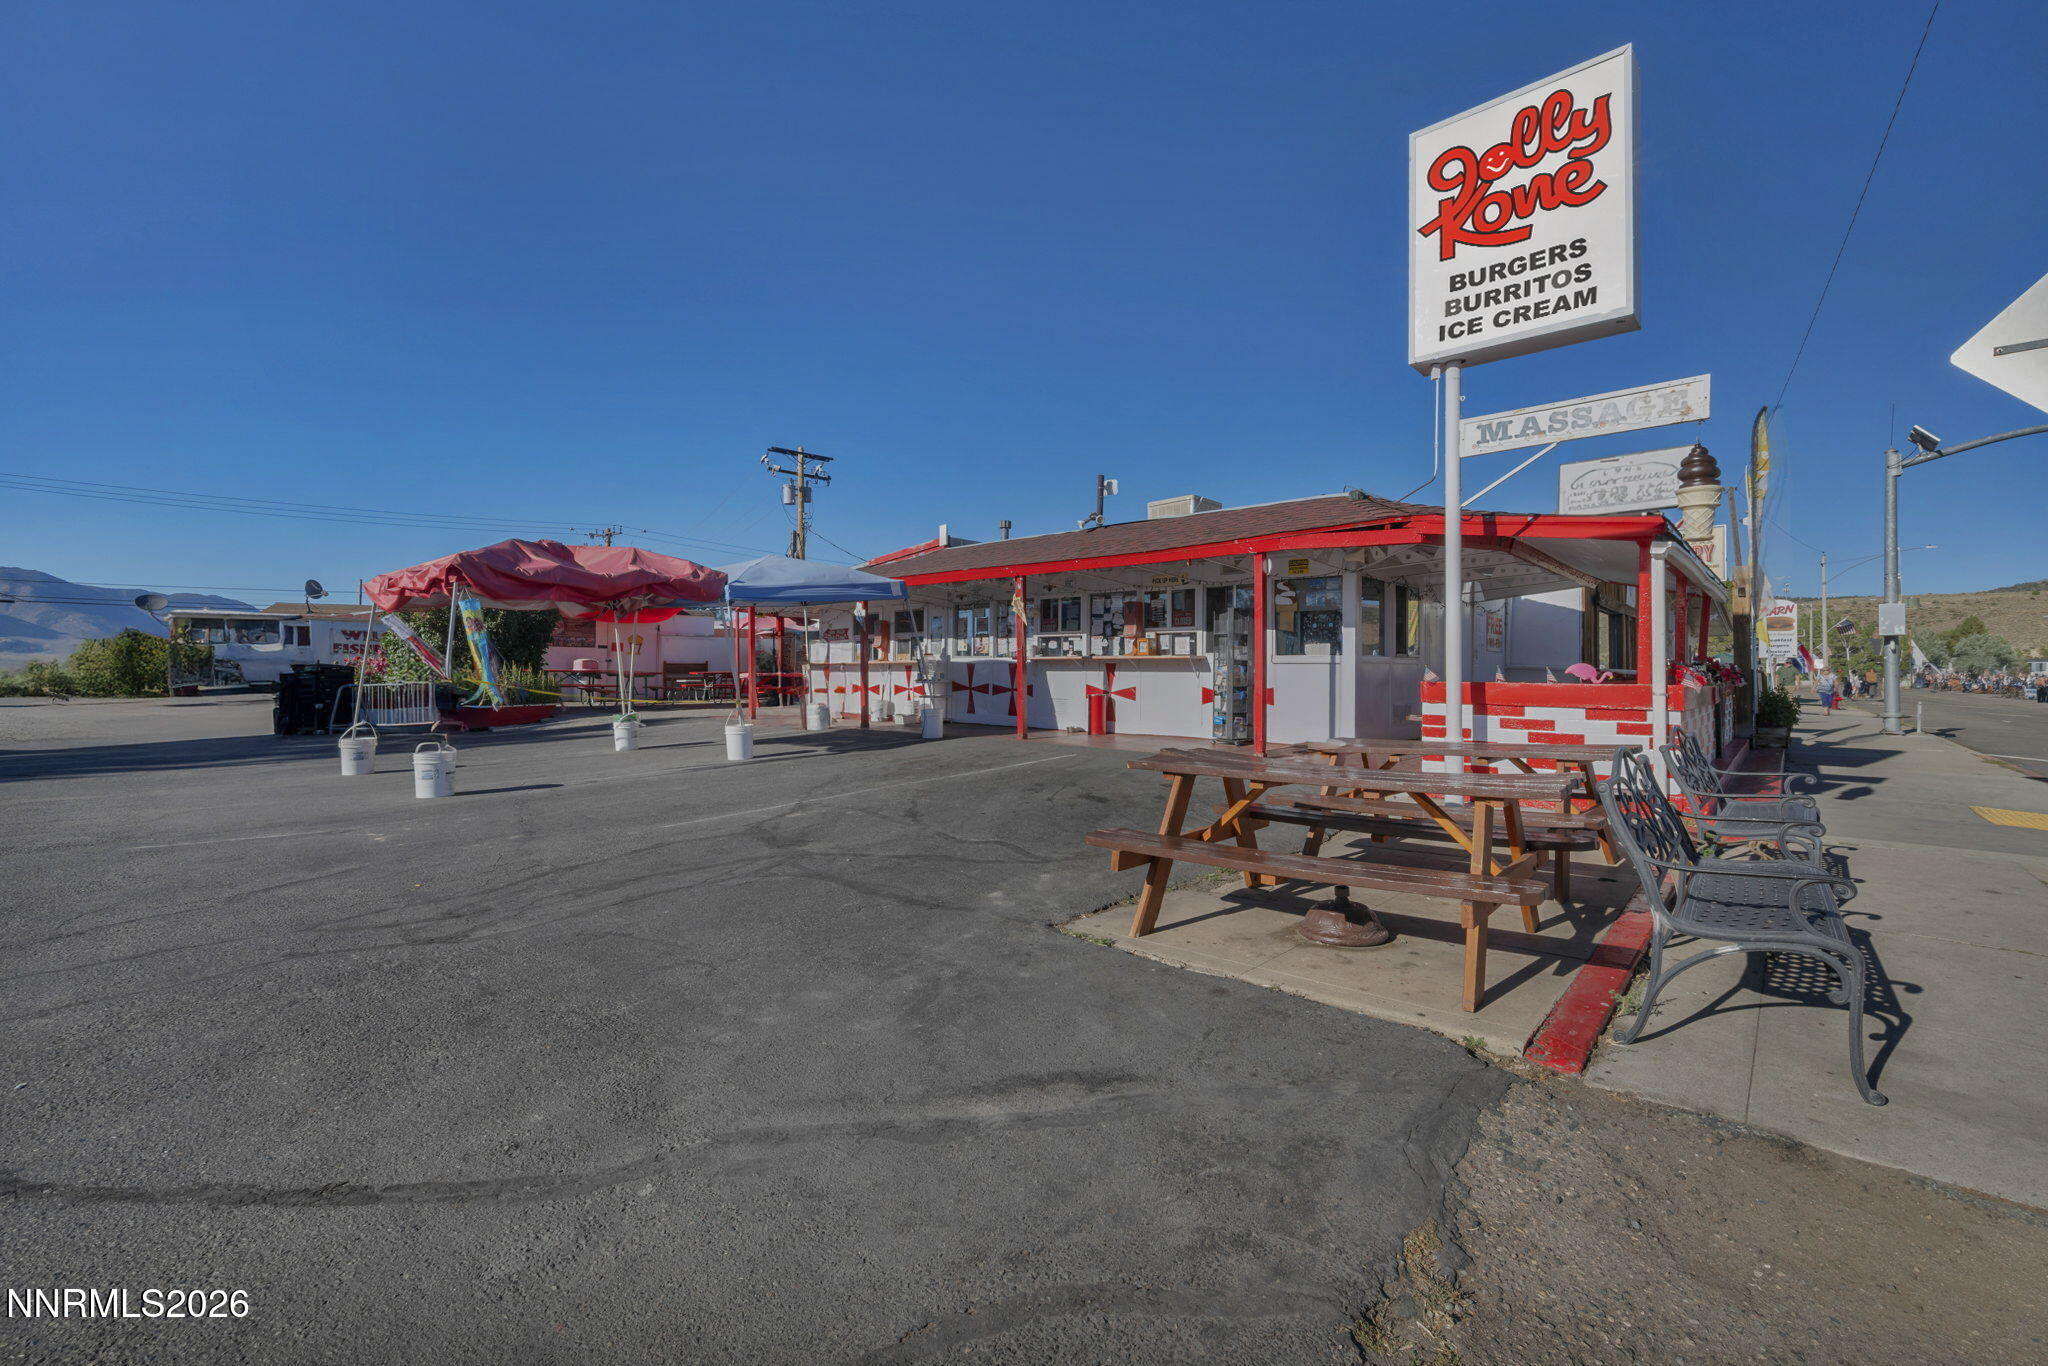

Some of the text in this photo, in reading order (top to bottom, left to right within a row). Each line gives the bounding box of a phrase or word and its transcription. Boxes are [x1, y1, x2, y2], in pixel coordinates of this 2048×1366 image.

[1422, 89, 1612, 222] Jolly
[1430, 159, 1608, 261] Kone
[1444, 262, 1592, 317] BURRITOS
[1449, 237, 1588, 293] BURGERS
[1439, 286, 1598, 342] ICE CREAM
[1476, 389, 1689, 445] MASSAGE
[1763, 604, 1795, 616] ARN
